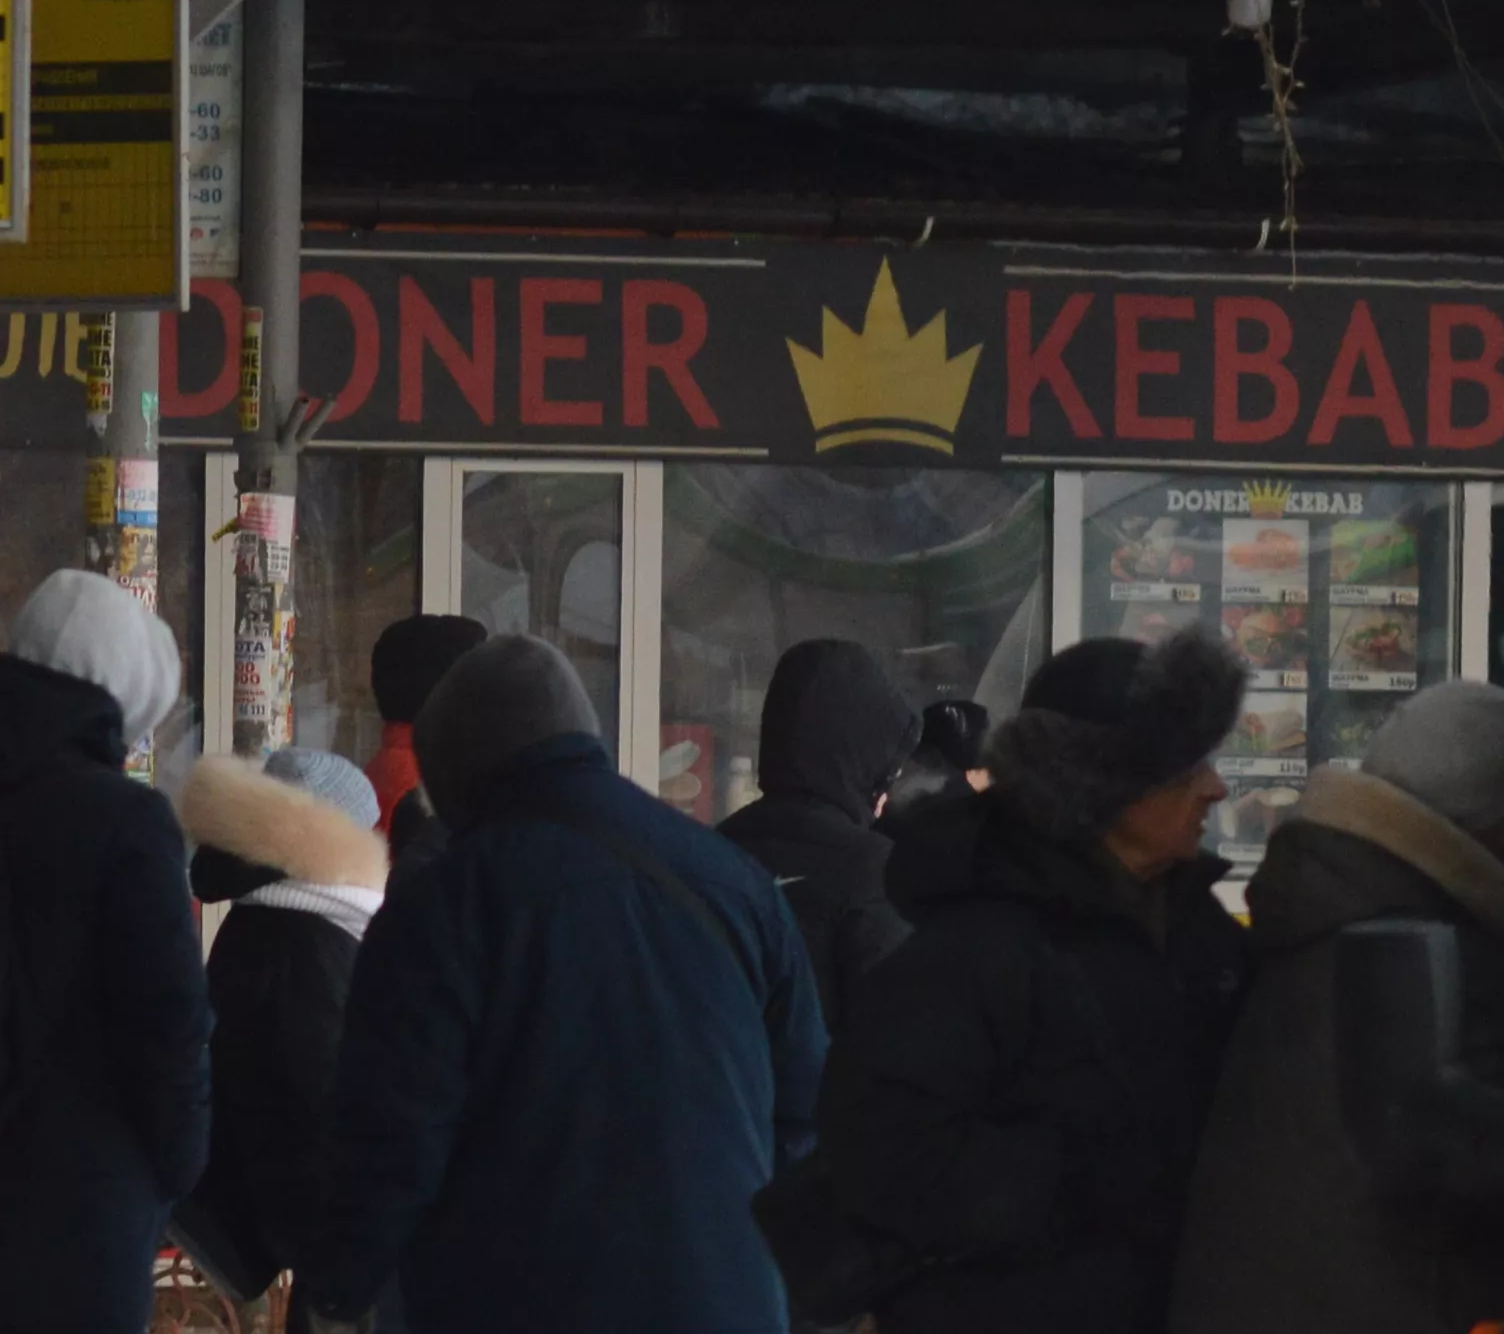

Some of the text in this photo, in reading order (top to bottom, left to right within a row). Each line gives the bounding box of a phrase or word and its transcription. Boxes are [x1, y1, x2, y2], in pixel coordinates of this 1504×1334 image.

[158, 273, 721, 432] DONER
[1167, 489, 1364, 515] DONER KEBAB
